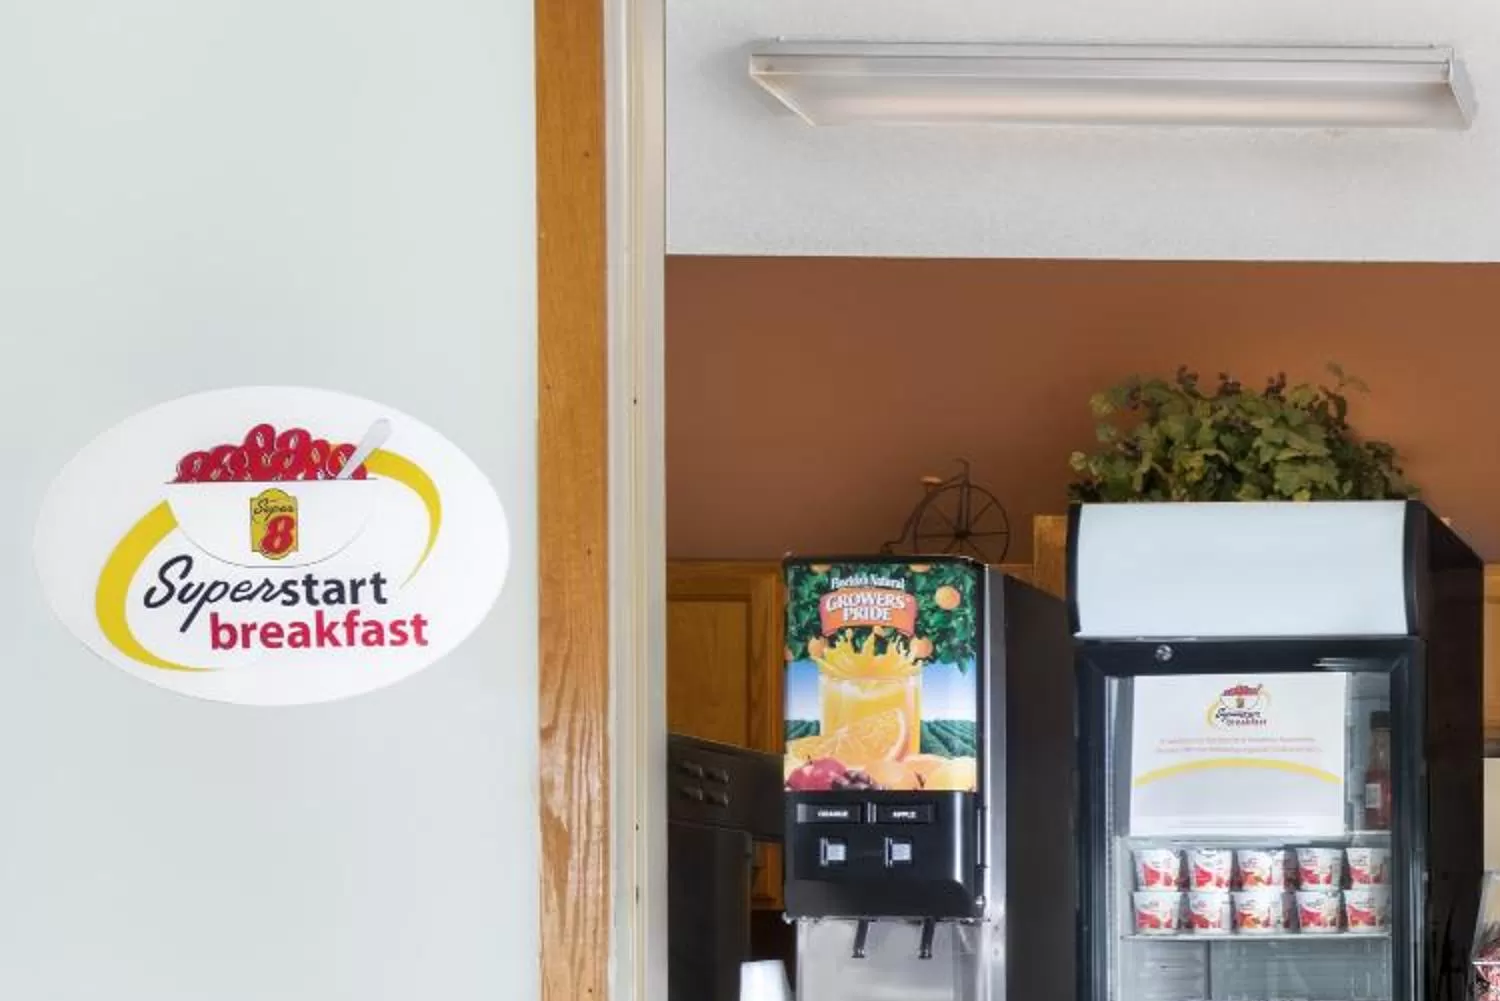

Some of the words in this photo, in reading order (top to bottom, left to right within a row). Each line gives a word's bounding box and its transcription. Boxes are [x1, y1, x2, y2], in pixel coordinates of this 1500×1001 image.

[254, 498, 294, 521] Super
[261, 513, 295, 555] 8
[144, 554, 388, 632] Superstart
[209, 609, 429, 650] breakfast
[843, 606, 892, 622] PRIDE
